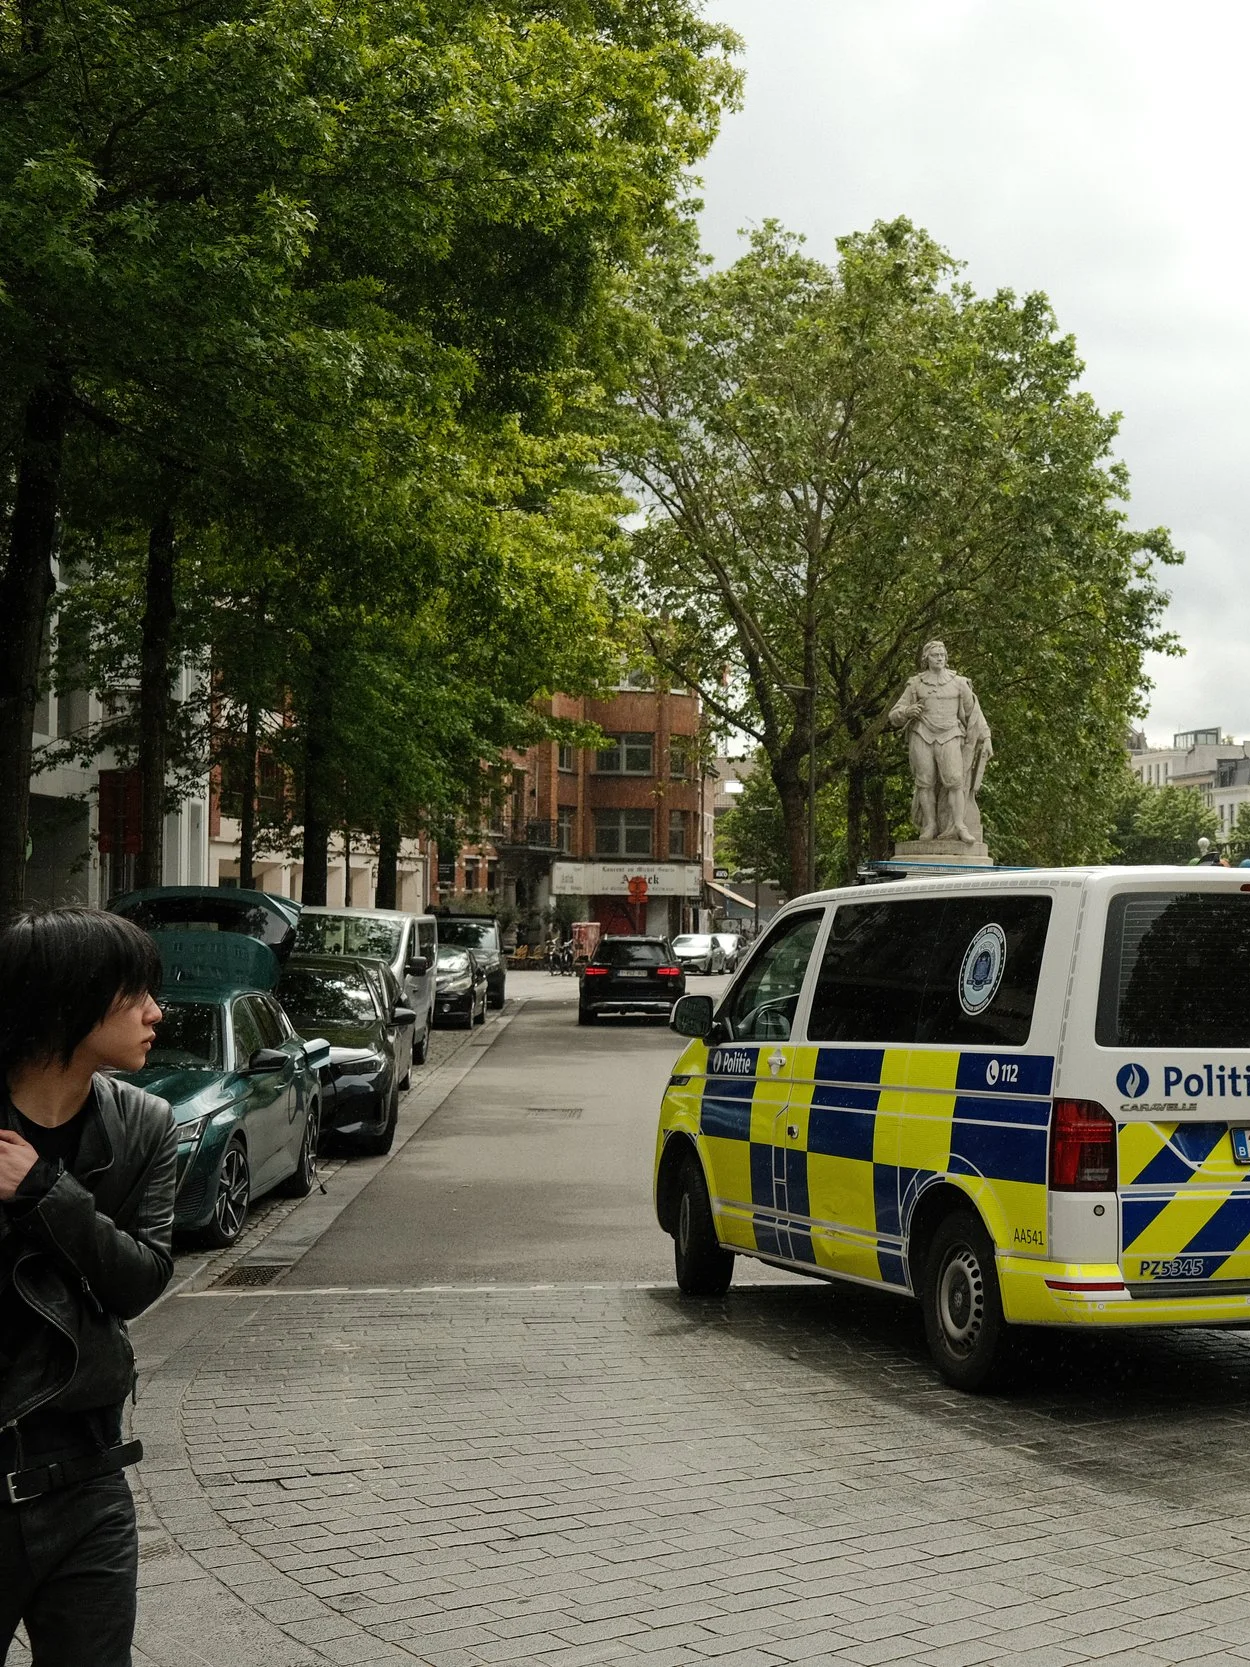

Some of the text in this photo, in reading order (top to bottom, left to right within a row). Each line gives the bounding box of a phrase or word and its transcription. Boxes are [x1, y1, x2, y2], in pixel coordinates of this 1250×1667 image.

[722, 1051, 751, 1073] Politie
[1001, 1064, 1018, 1083] 112
[1119, 1103, 1198, 1112] CARAVELLE
[1013, 1228, 1044, 1246] AA541
[1140, 1258, 1204, 1277] PZ5345
